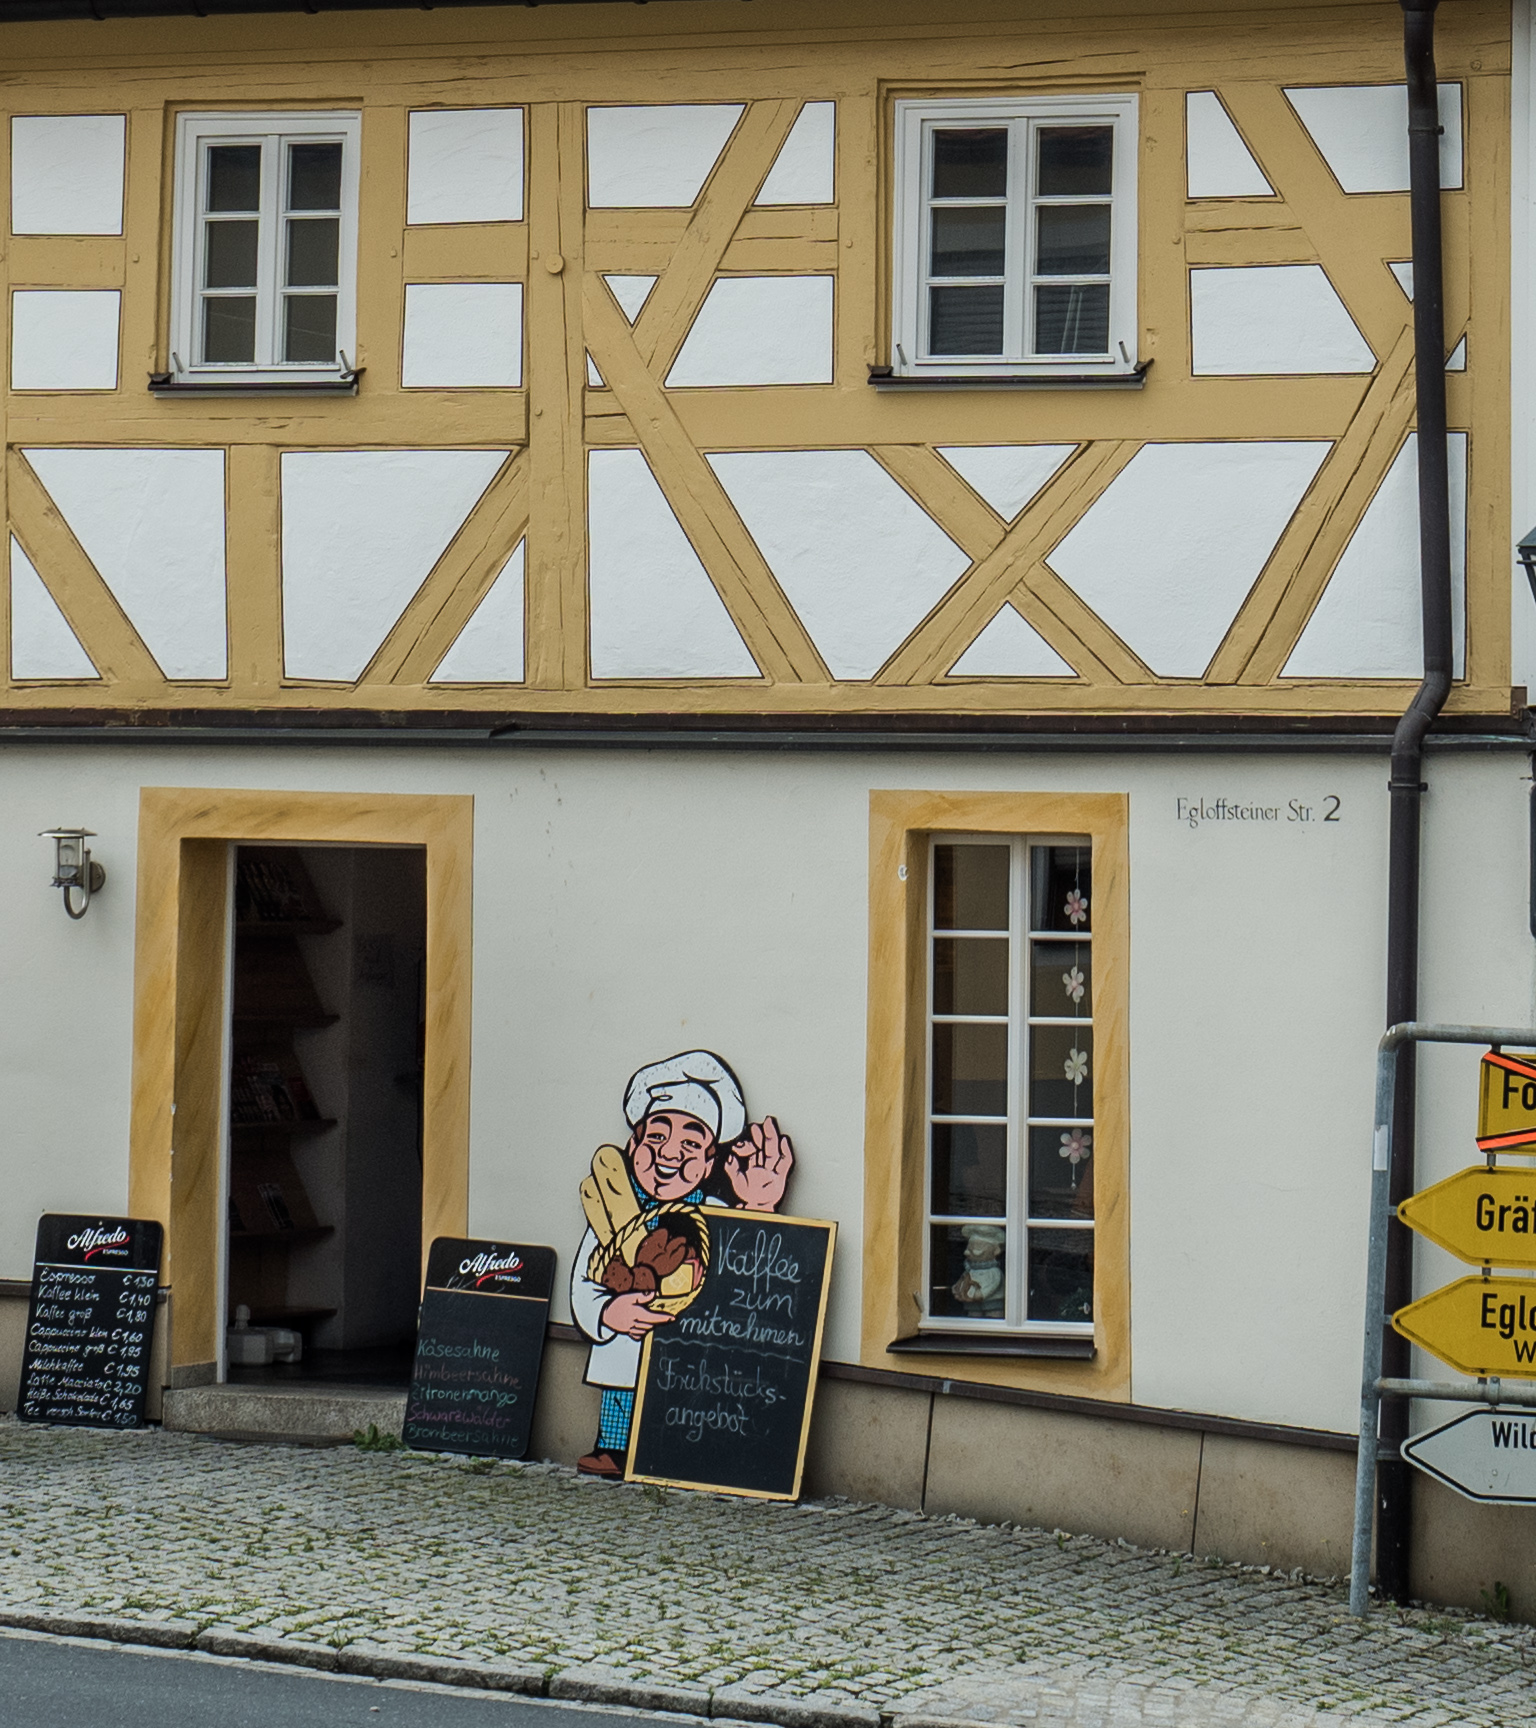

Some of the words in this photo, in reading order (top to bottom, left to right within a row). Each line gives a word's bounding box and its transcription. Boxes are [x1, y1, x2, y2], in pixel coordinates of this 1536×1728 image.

[1176, 797, 1280, 829] Egloffsteiner
[1287, 798, 1315, 822] Str.
[1323, 795, 1341, 822] 2
[67, 1226, 127, 1251] Alfredo
[459, 1251, 520, 1277] Alfredo
[718, 1227, 802, 1294] Kaffee
[39, 1267, 97, 1284] Espresso
[37, 1284, 71, 1302] Kaffee
[74, 1288, 100, 1302] klein
[729, 1288, 794, 1319] zum
[35, 1303, 64, 1321] Kaffee
[68, 1307, 93, 1326] groß
[679, 1305, 805, 1347] mitnehmen
[417, 1338, 500, 1362] Käsesahne
[28, 1358, 84, 1374] Milchkaffee
[23, 1401, 40, 1416] Tee
[665, 1402, 749, 1443] angebot
